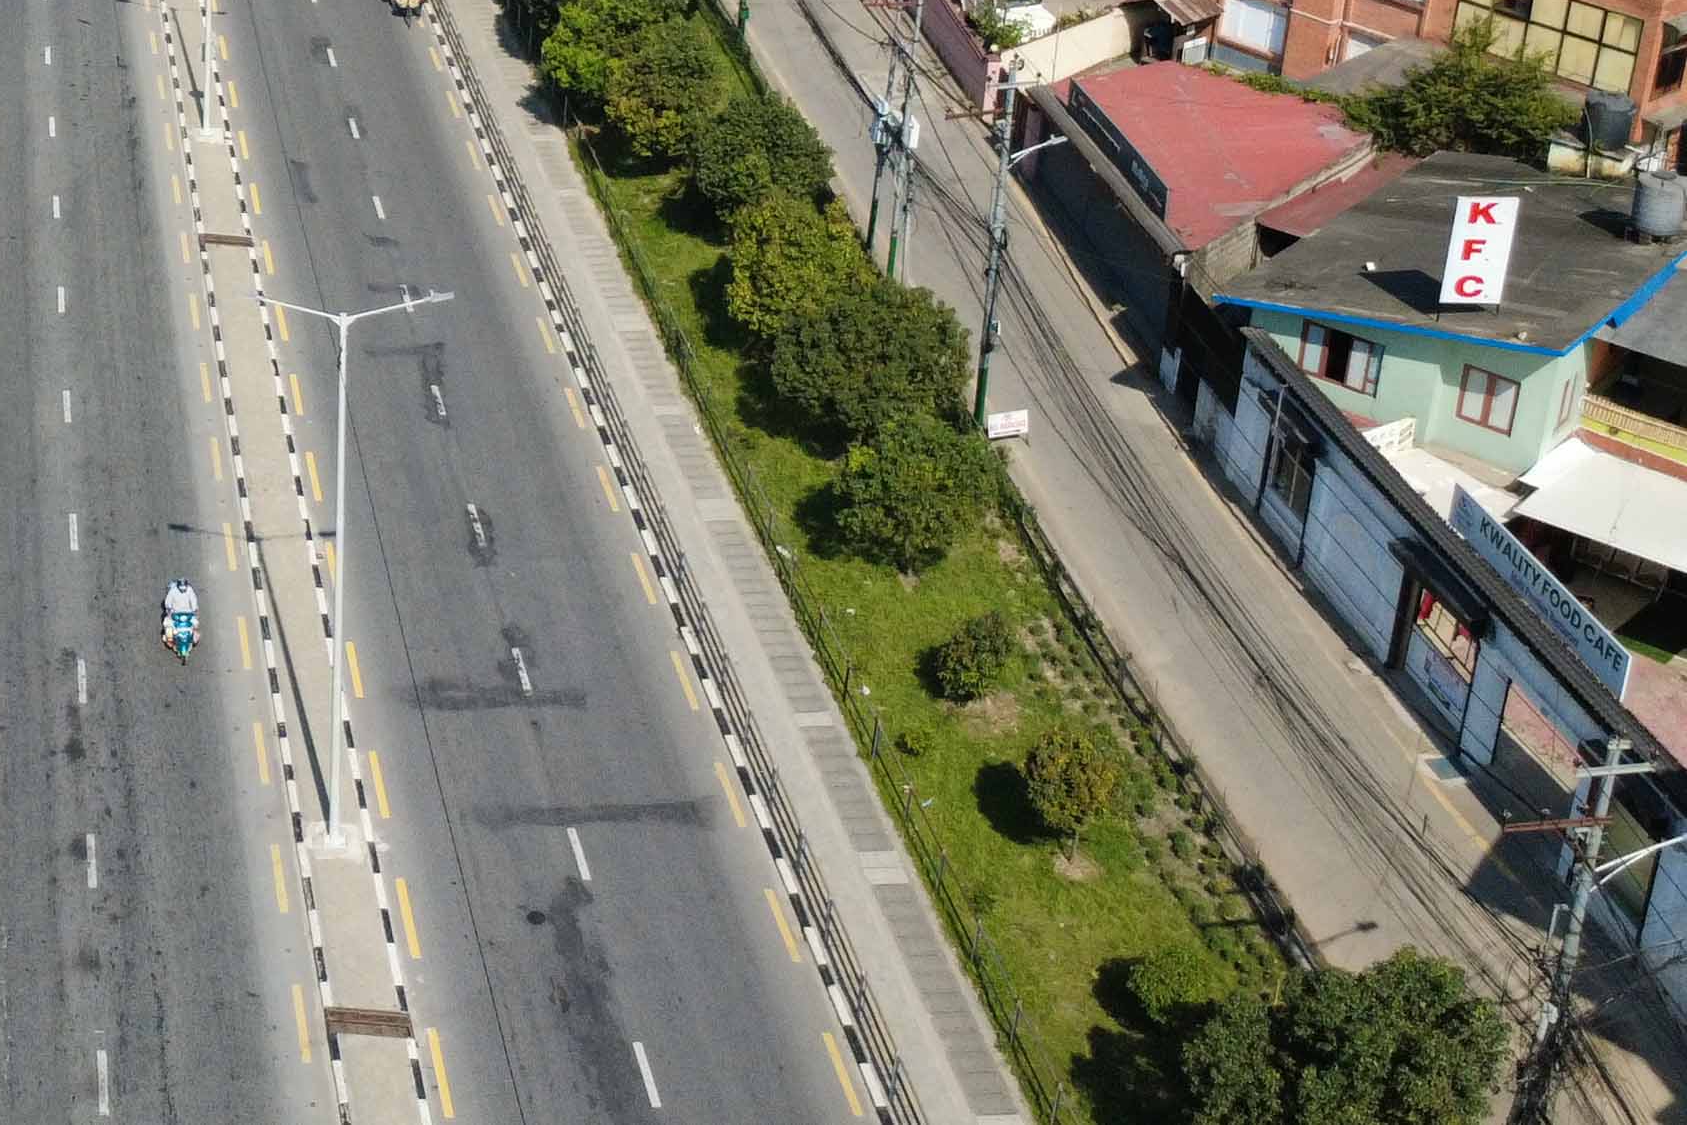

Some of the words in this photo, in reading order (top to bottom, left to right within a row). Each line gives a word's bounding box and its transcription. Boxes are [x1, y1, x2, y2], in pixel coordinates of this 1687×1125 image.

[1480, 517, 1541, 586] KWALITY
[1541, 581, 1582, 626] FOOD
[1583, 626, 1623, 672] CAFE
